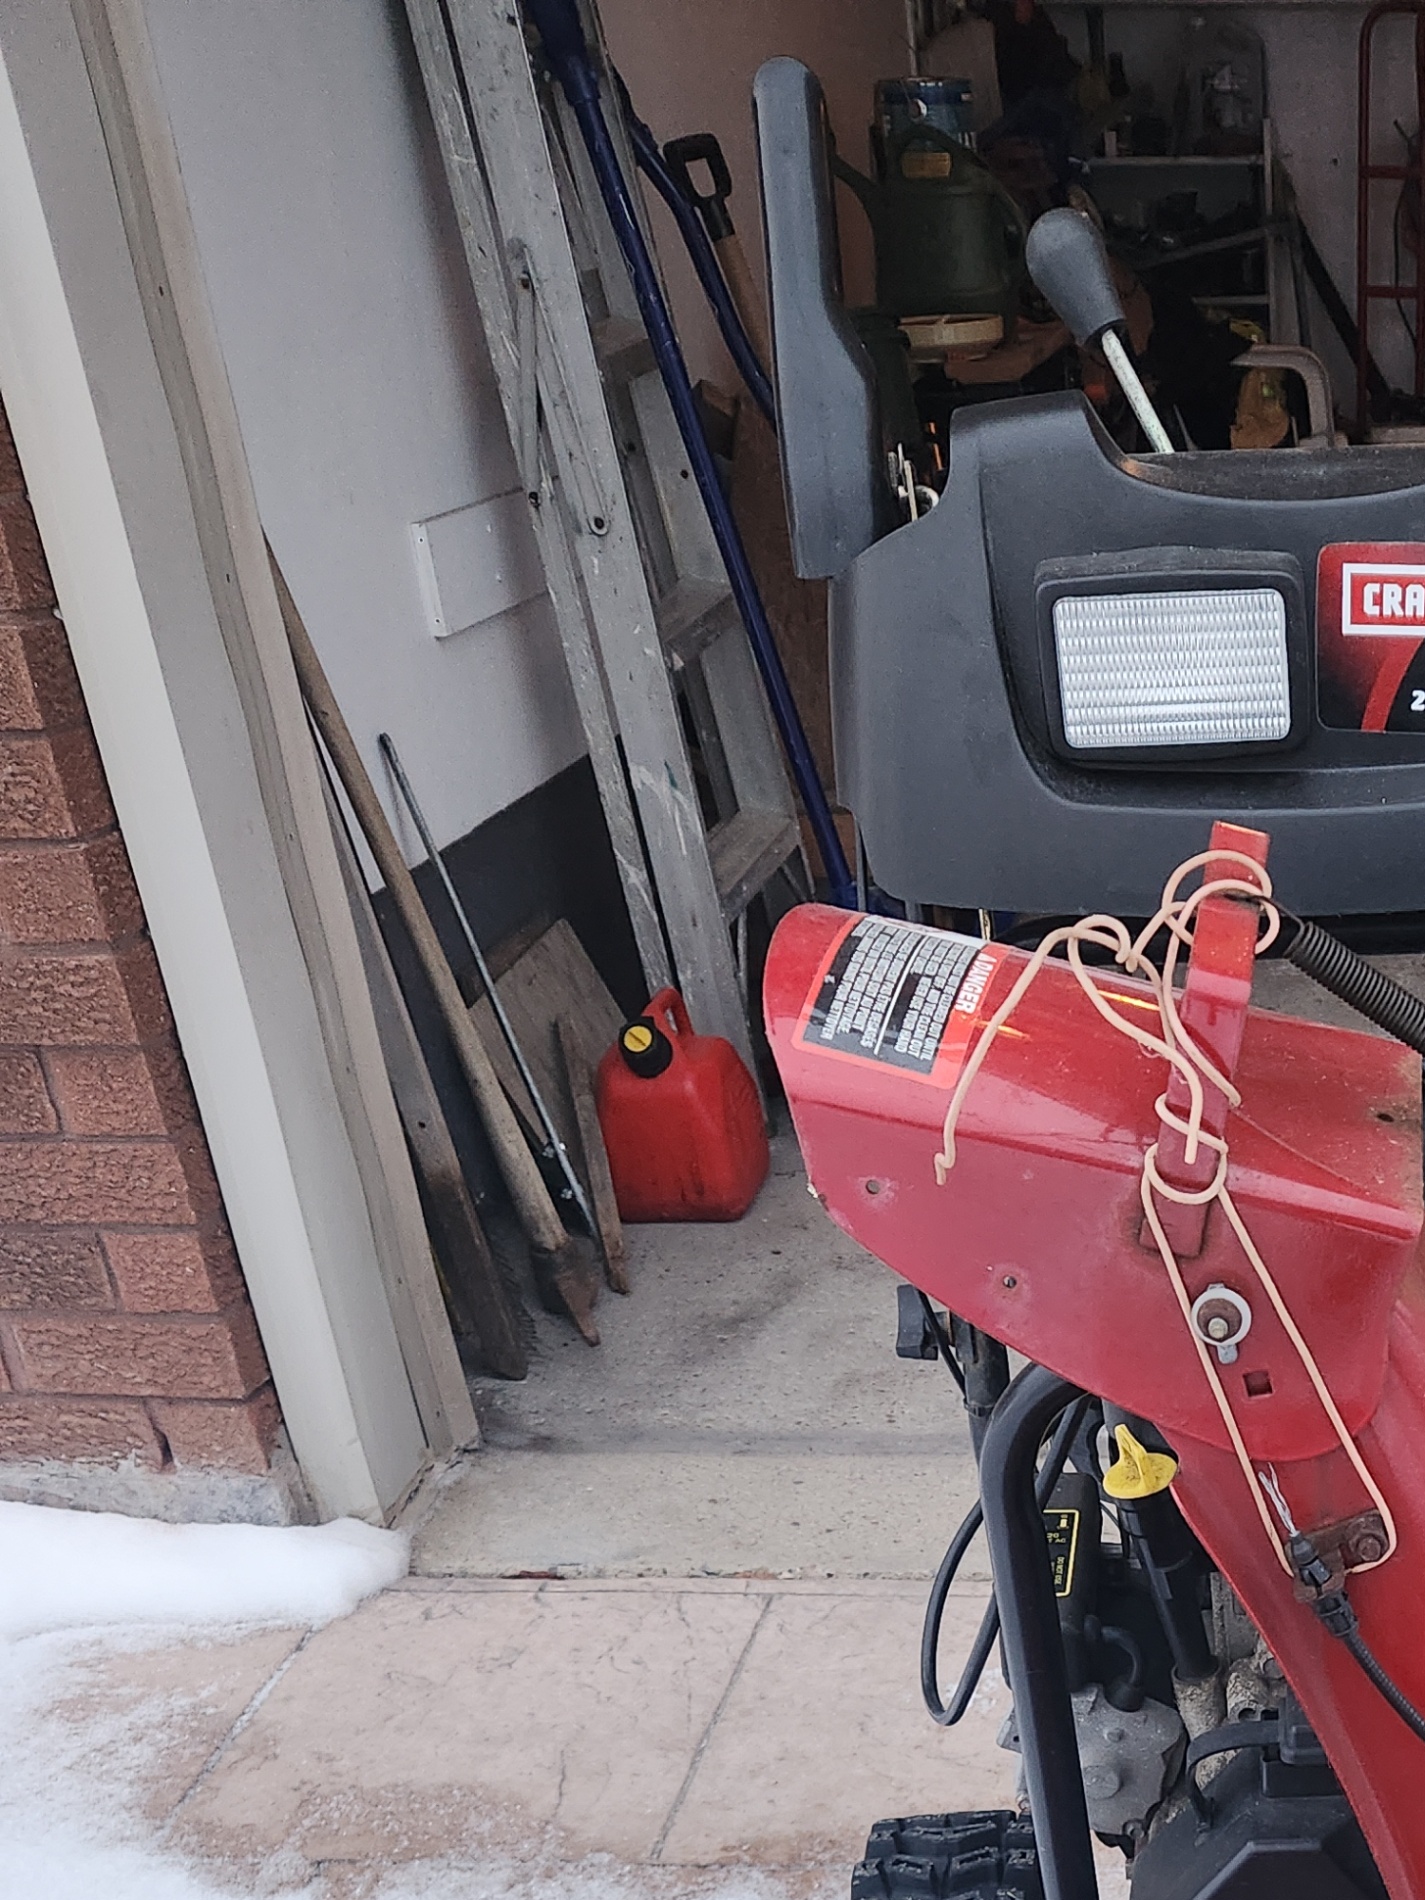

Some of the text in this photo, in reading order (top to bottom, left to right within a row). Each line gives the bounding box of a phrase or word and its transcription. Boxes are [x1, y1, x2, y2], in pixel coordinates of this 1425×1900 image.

[953, 960, 993, 1013] DANGER
[907, 1039, 923, 1058] OUT
[920, 1037, 938, 1060] UNTIL
